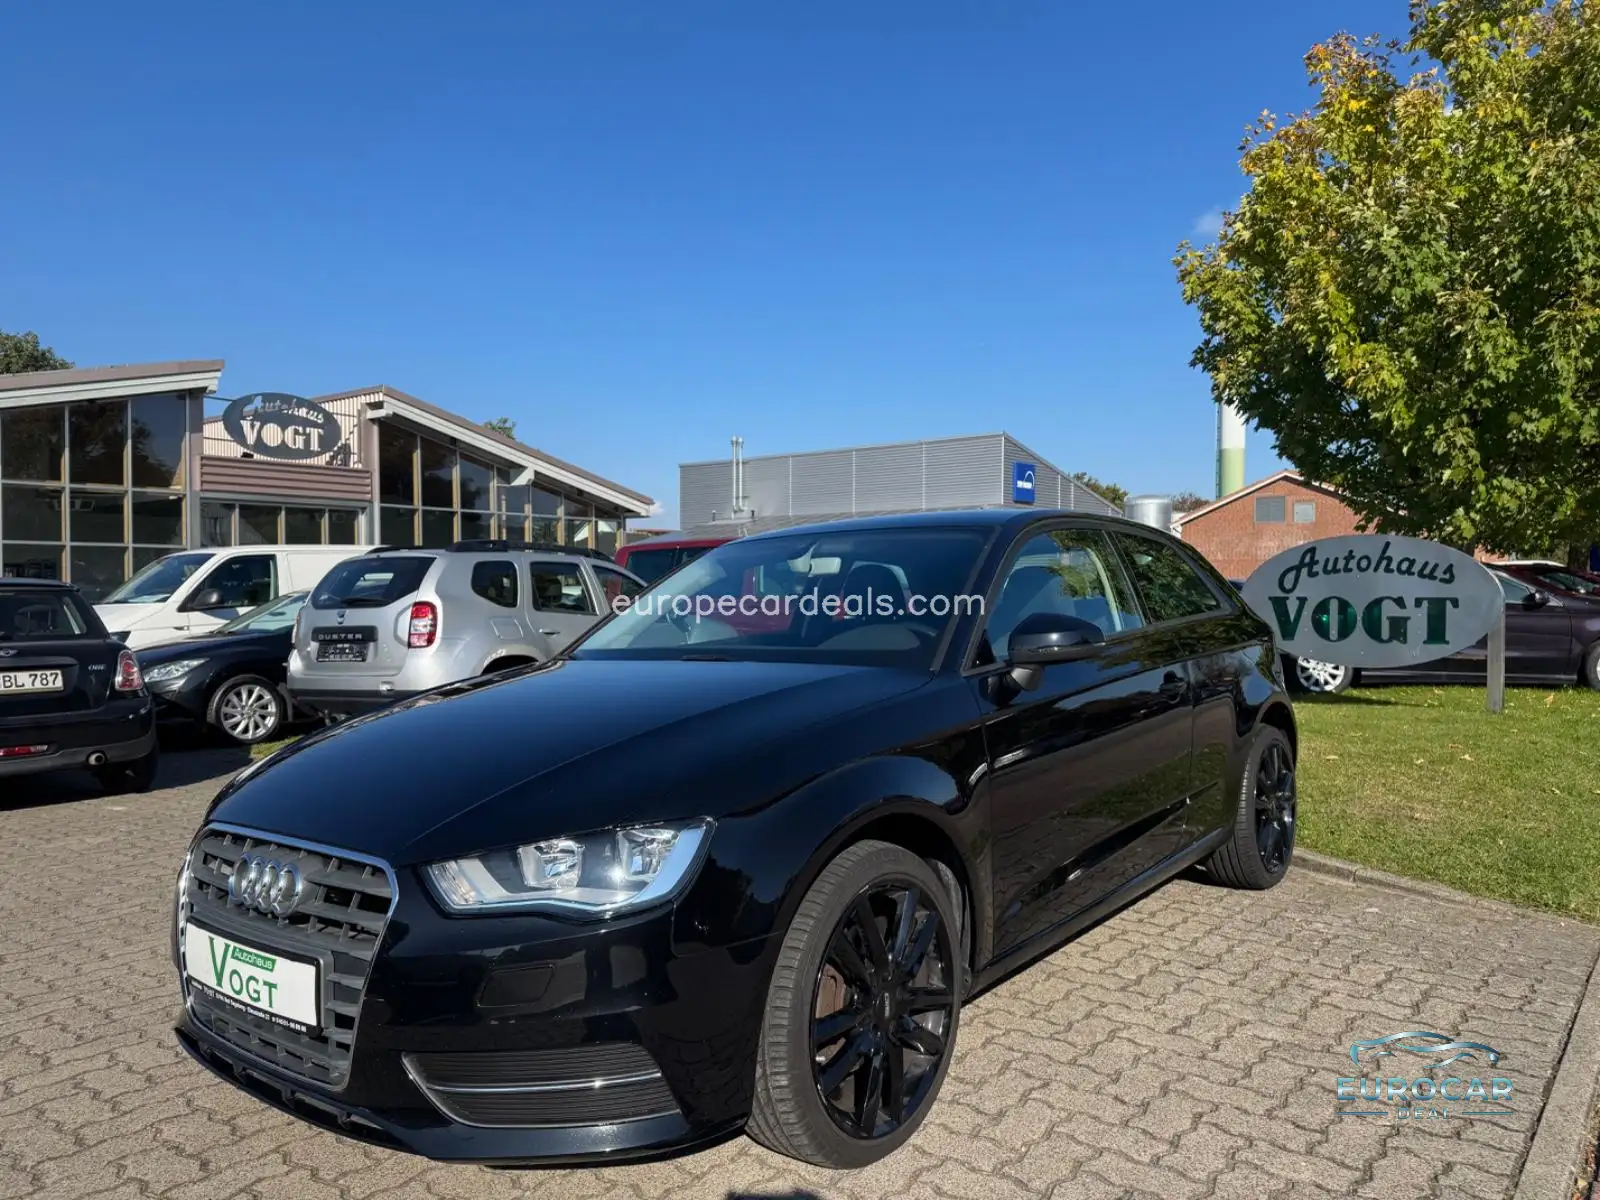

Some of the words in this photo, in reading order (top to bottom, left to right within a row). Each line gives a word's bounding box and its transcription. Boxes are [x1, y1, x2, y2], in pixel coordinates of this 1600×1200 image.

[240, 419, 324, 452] VOGT
[1278, 541, 1456, 594] Autohaus
[1268, 596, 1459, 645] VOGT
[29, 672, 59, 687] 787
[208, 936, 278, 1008] VOGT
[233, 948, 274, 969] Autohaus
